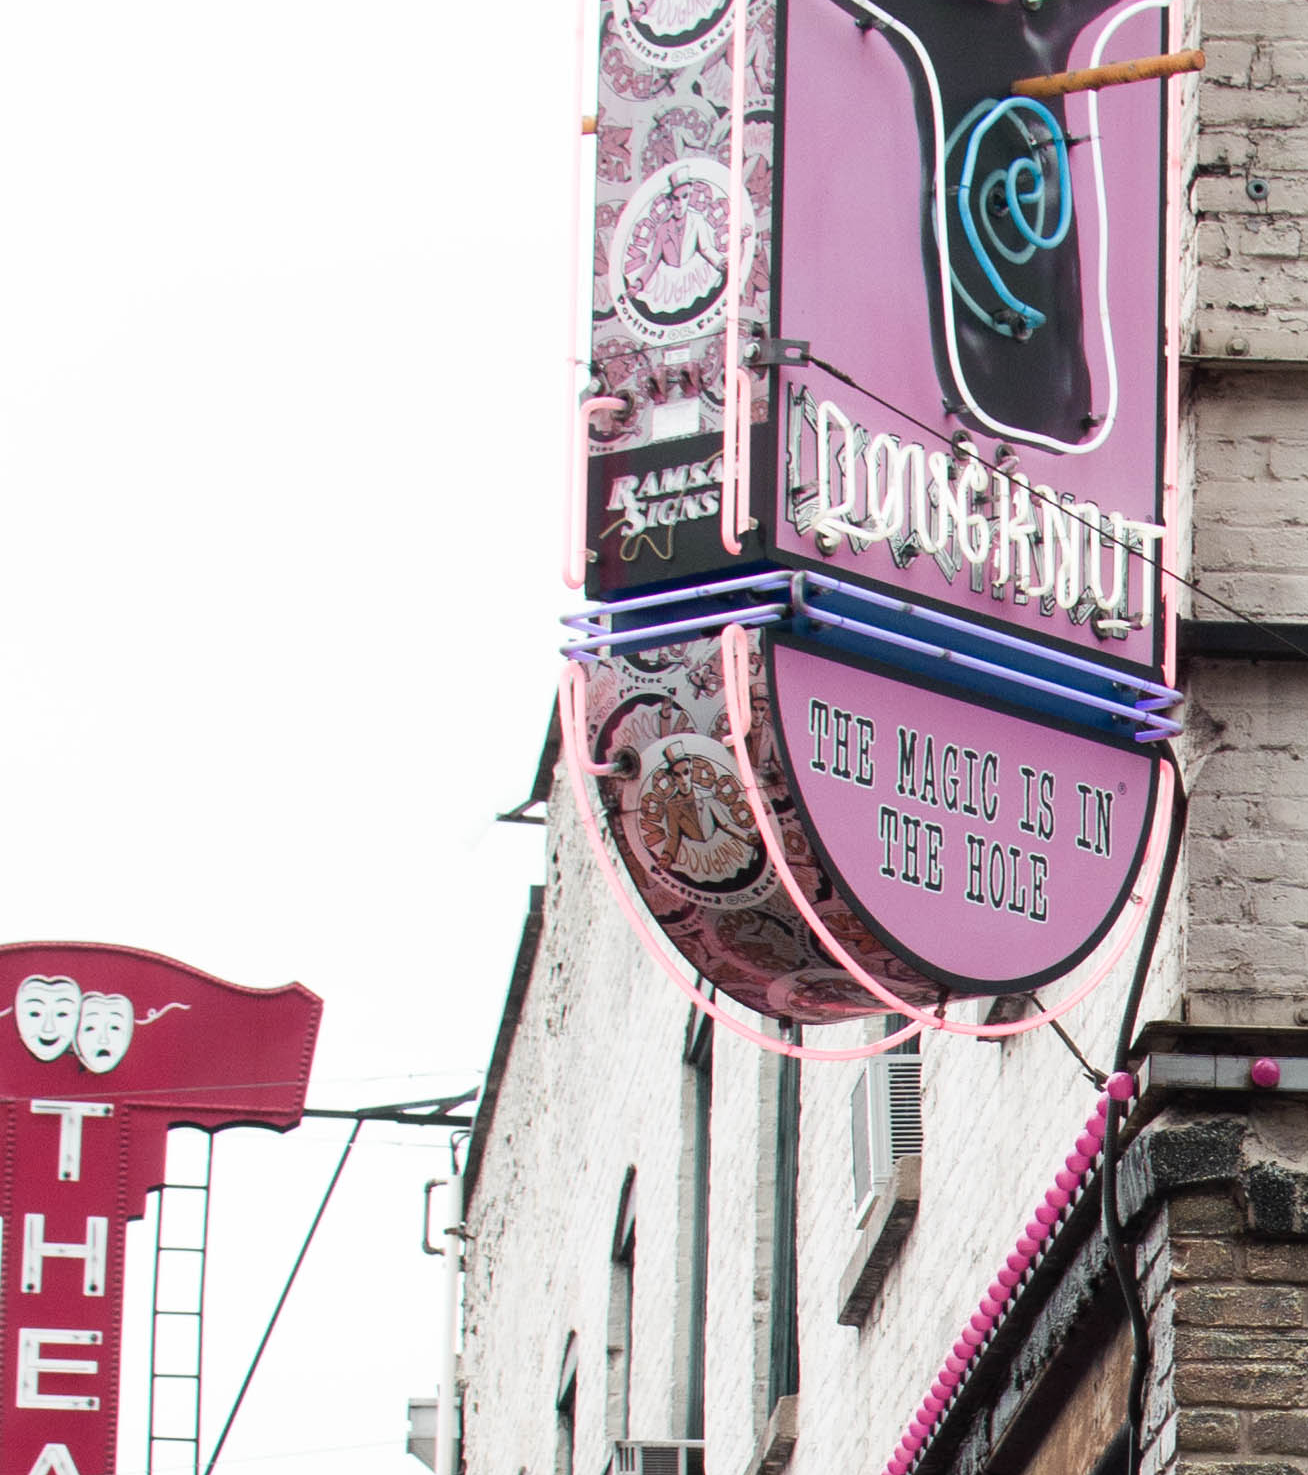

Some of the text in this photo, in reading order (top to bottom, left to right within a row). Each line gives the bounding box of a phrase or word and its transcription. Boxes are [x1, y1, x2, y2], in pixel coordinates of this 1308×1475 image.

[605, 455, 724, 511] RAMSA
[620, 489, 720, 539] SIGNS
[785, 381, 1168, 640] DOUGHNUT
[640, 755, 757, 848] VOODOO
[809, 697, 1114, 858] THE MAGIC IS IN
[879, 803, 1049, 924] THE HOLE
